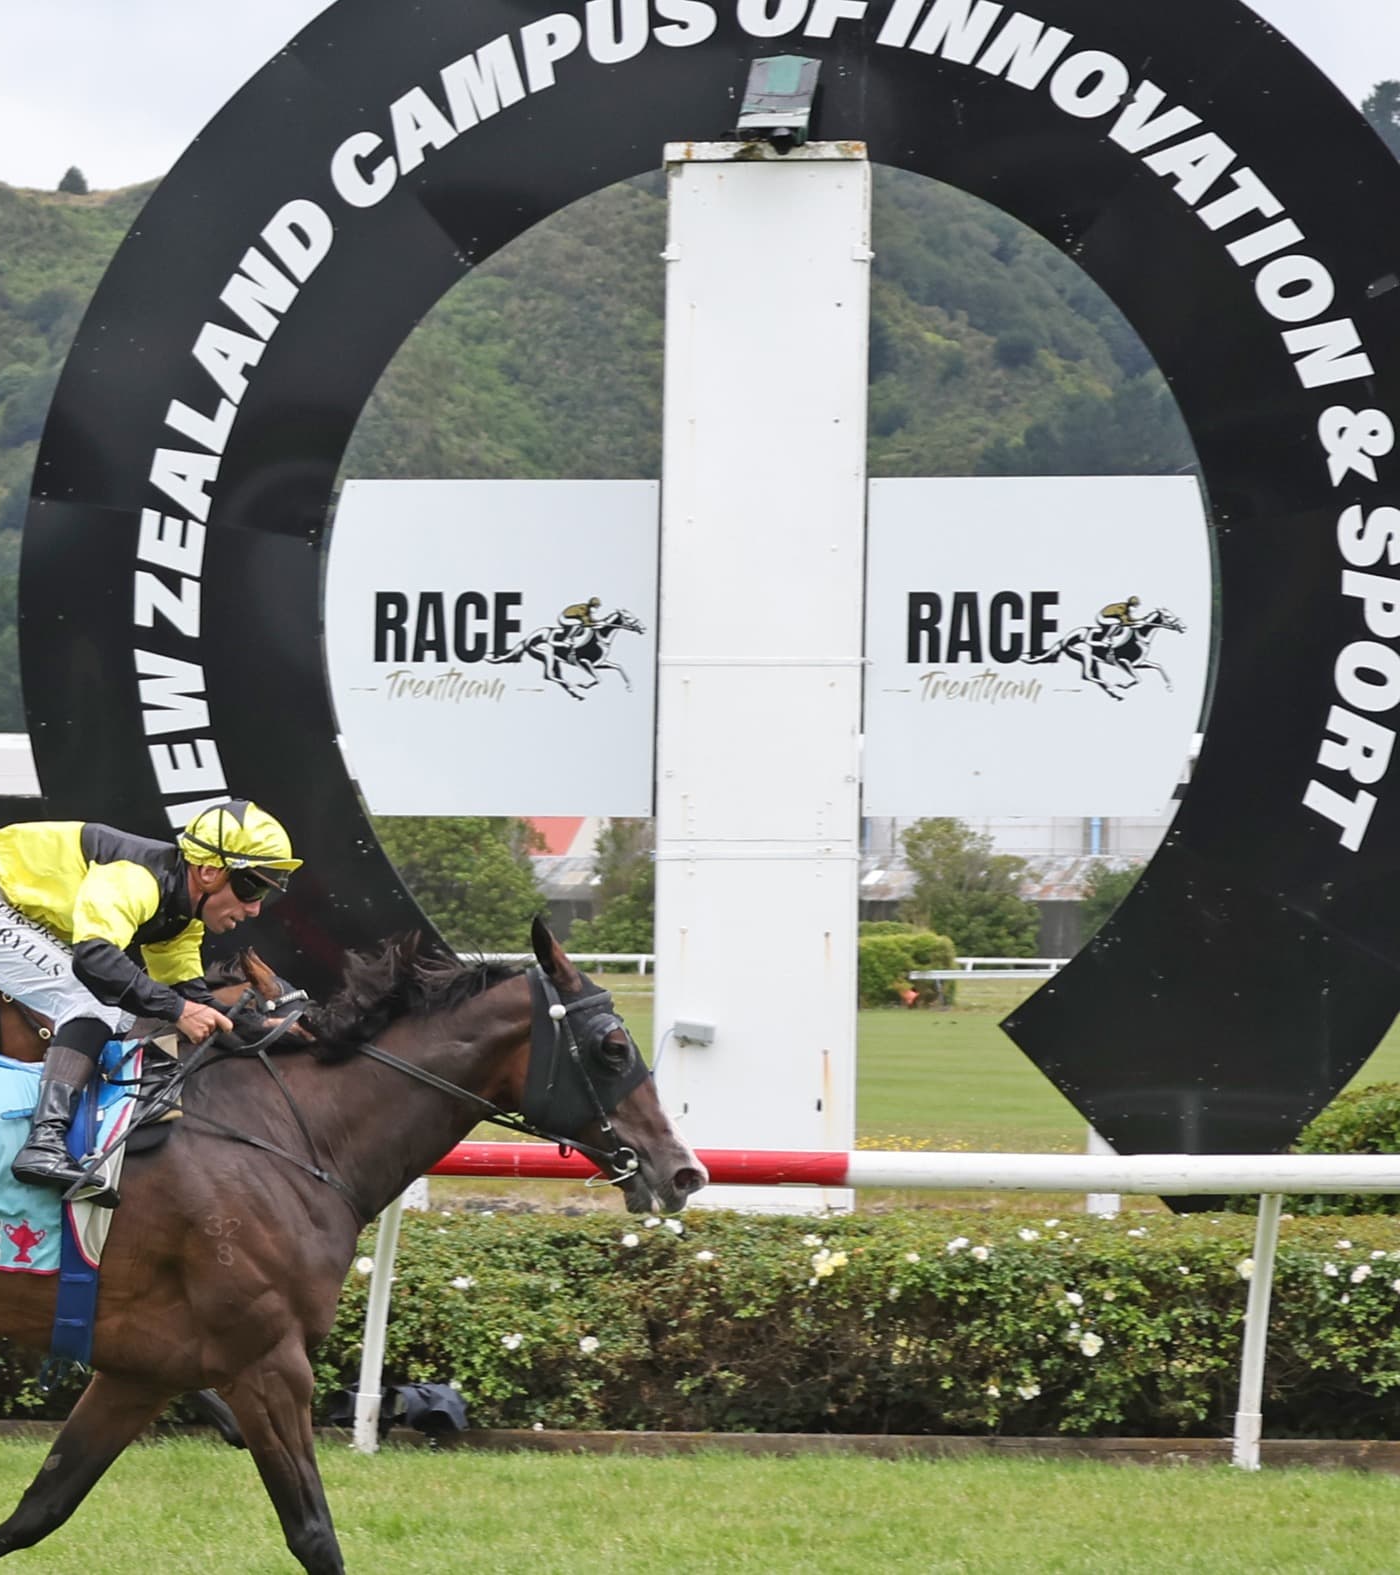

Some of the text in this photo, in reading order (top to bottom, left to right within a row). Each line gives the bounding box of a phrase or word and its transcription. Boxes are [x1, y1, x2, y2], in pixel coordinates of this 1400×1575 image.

[330, 0, 718, 208] CAMPUS
[875, 0, 1375, 389] INNOVATION
[134, 198, 334, 638] ZEALAND
[1317, 405, 1395, 488] &
[373, 590, 523, 664] RACE
[905, 589, 1060, 664] RACE
[384, 666, 506, 704] Trentham
[918, 667, 1043, 705] Trentham
[1302, 504, 1400, 853] SPORT
